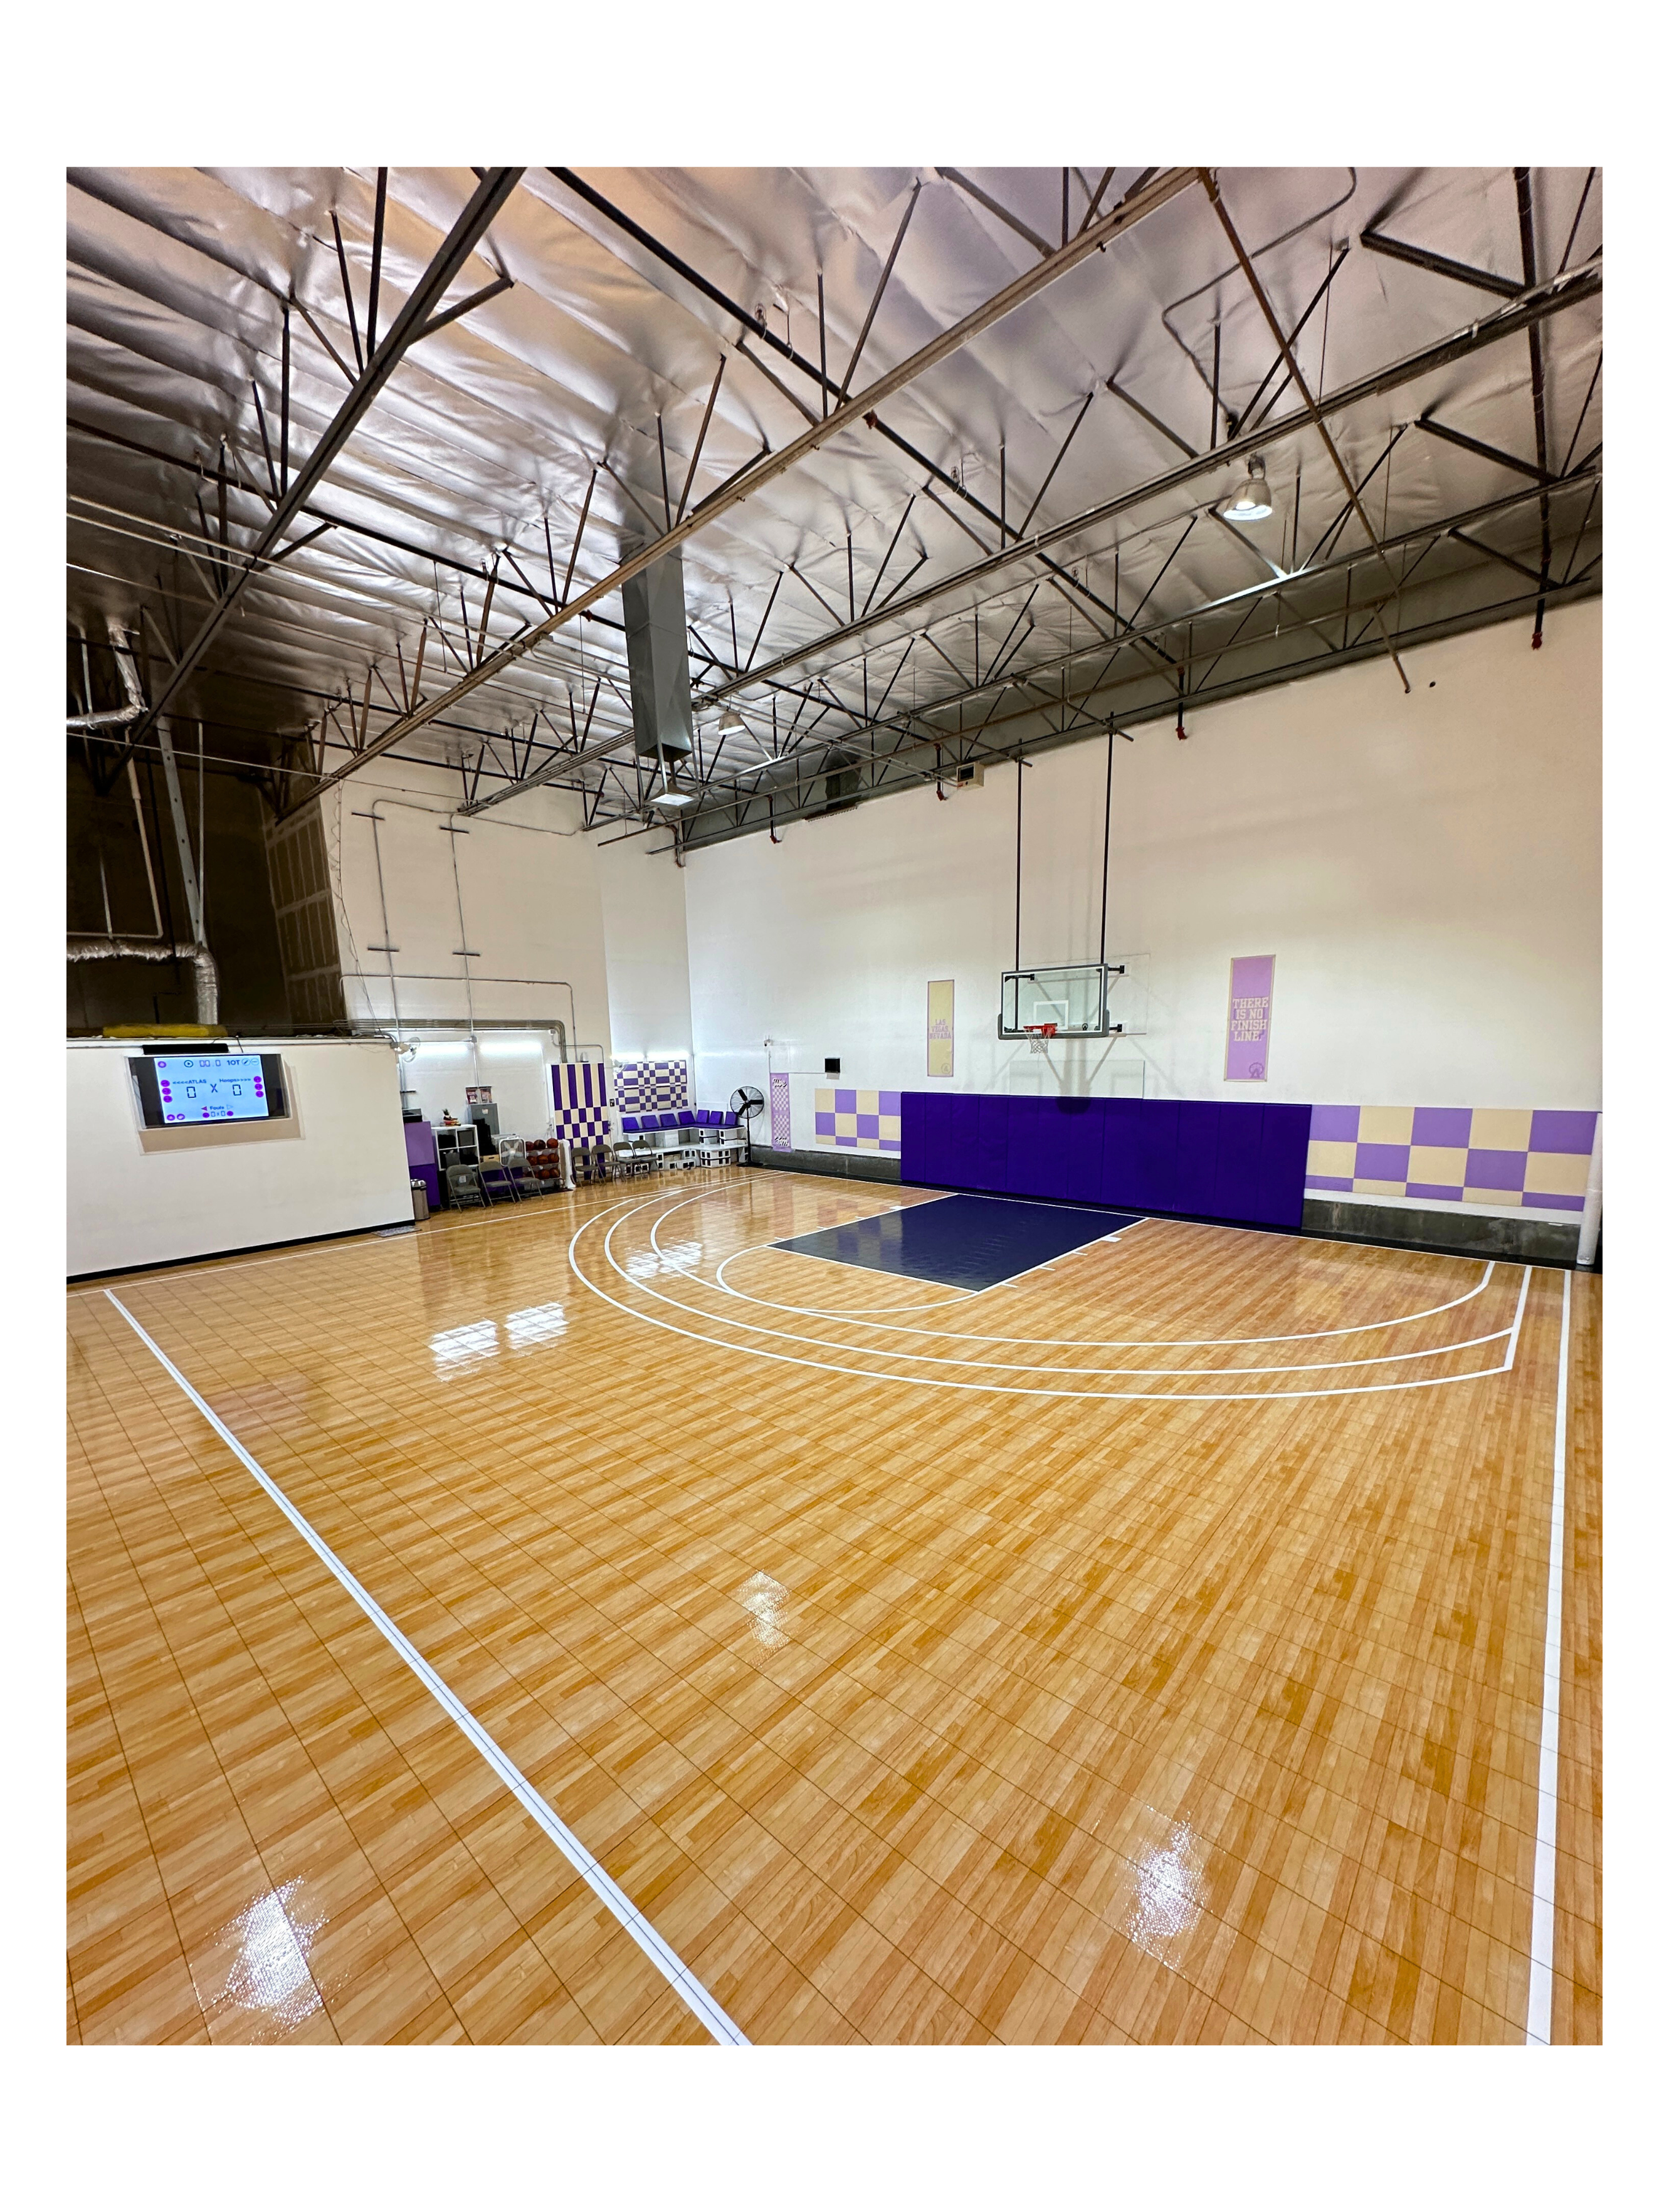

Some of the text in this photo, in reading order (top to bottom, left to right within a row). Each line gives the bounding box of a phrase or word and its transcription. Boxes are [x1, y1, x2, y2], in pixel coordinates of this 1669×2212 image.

[1232, 997, 1268, 1009] THERE
[1236, 1008, 1263, 1019] IS NO
[1231, 1019, 1267, 1031] FINISH
[929, 1031, 952, 1040] NEVADA
[1234, 1031, 1261, 1041] LINE.
